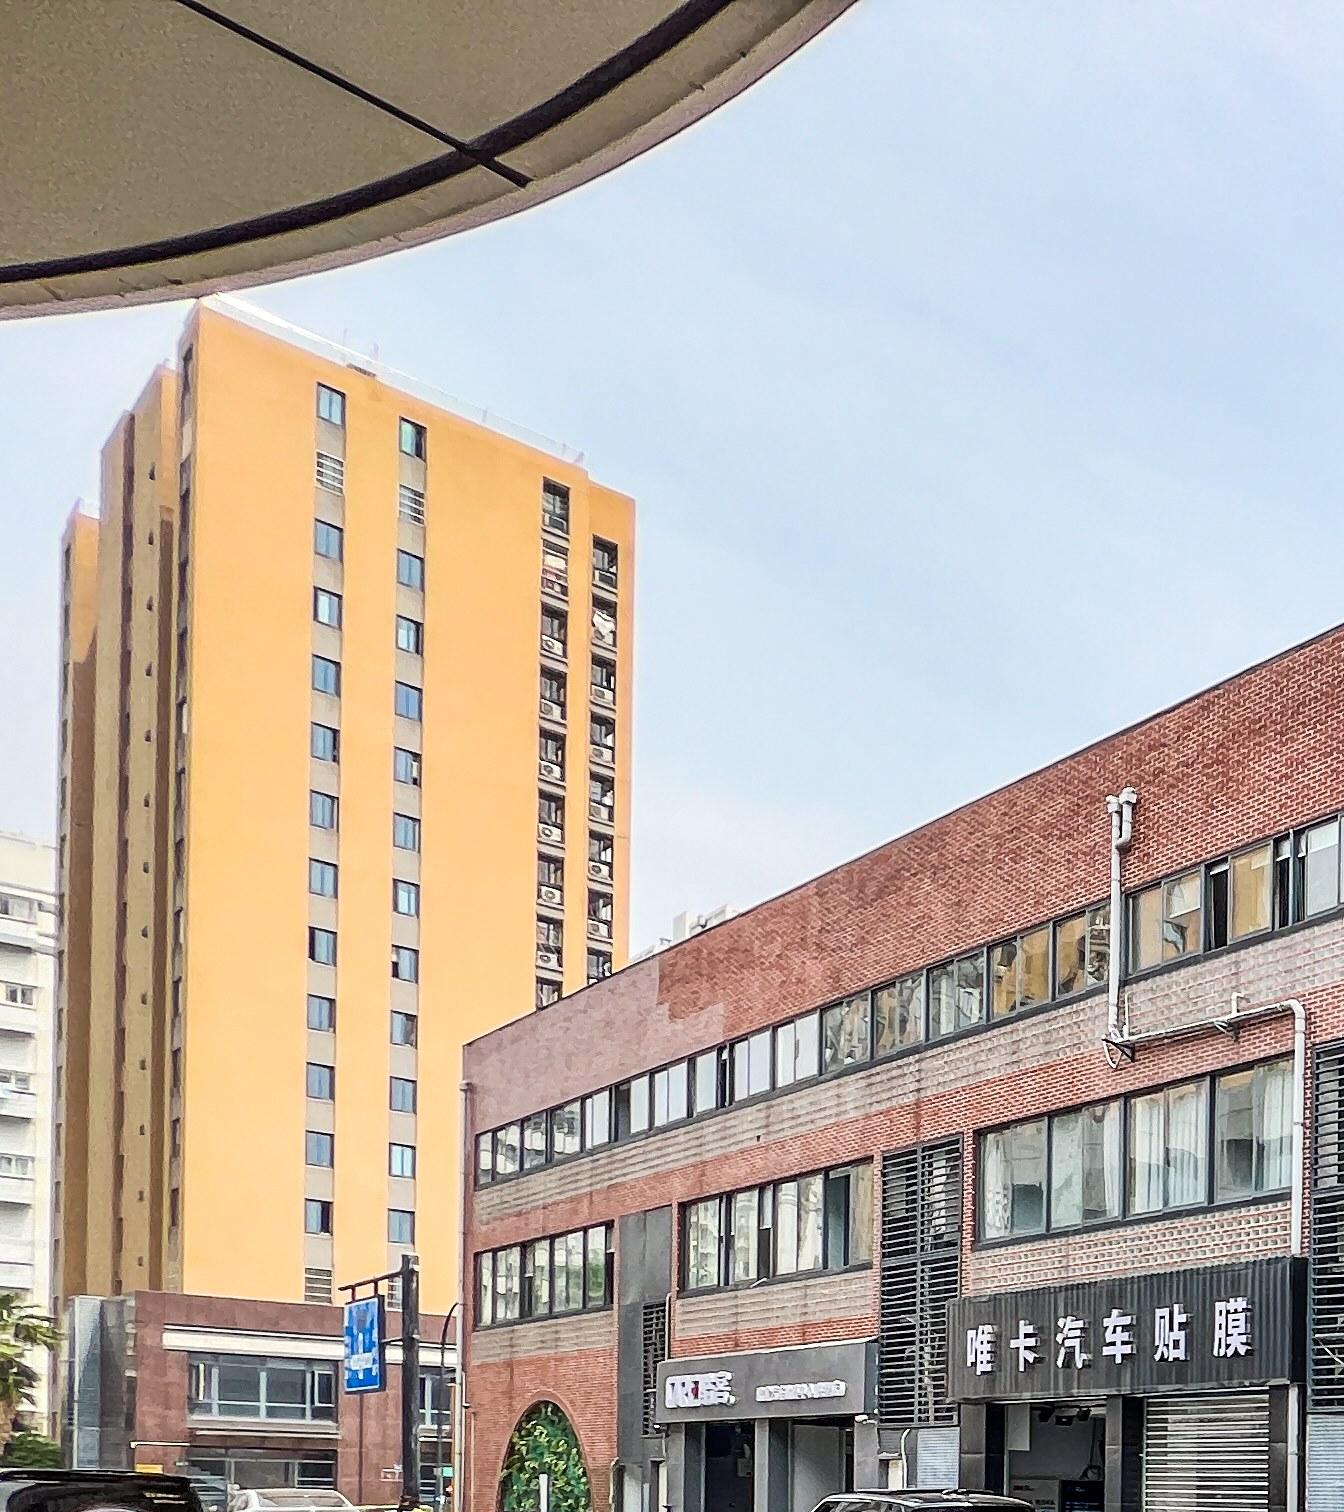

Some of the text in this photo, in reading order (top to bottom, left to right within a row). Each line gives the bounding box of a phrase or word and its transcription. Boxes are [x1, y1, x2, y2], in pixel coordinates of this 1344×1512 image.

[966, 1297, 1254, 1376] 唯卡汽车贴膜
